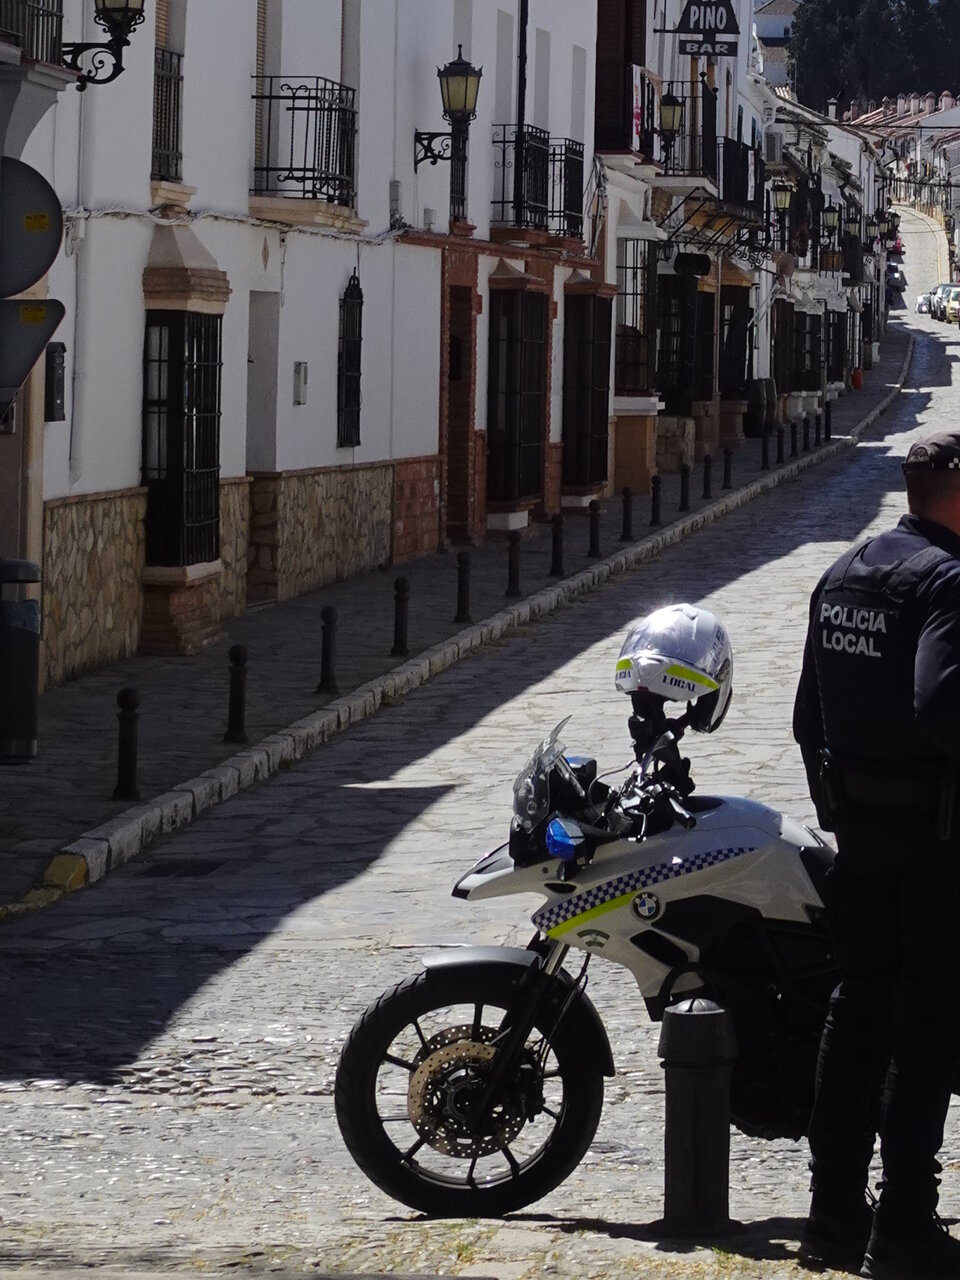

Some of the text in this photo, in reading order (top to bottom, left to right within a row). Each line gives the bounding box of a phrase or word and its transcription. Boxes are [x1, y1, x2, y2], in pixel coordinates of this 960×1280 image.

[690, 5, 727, 30] PINO
[685, 43, 728, 53] BAR
[820, 603, 887, 633] POLICIA
[823, 630, 881, 657] LOCAL
[662, 675, 696, 692] LOCAL
